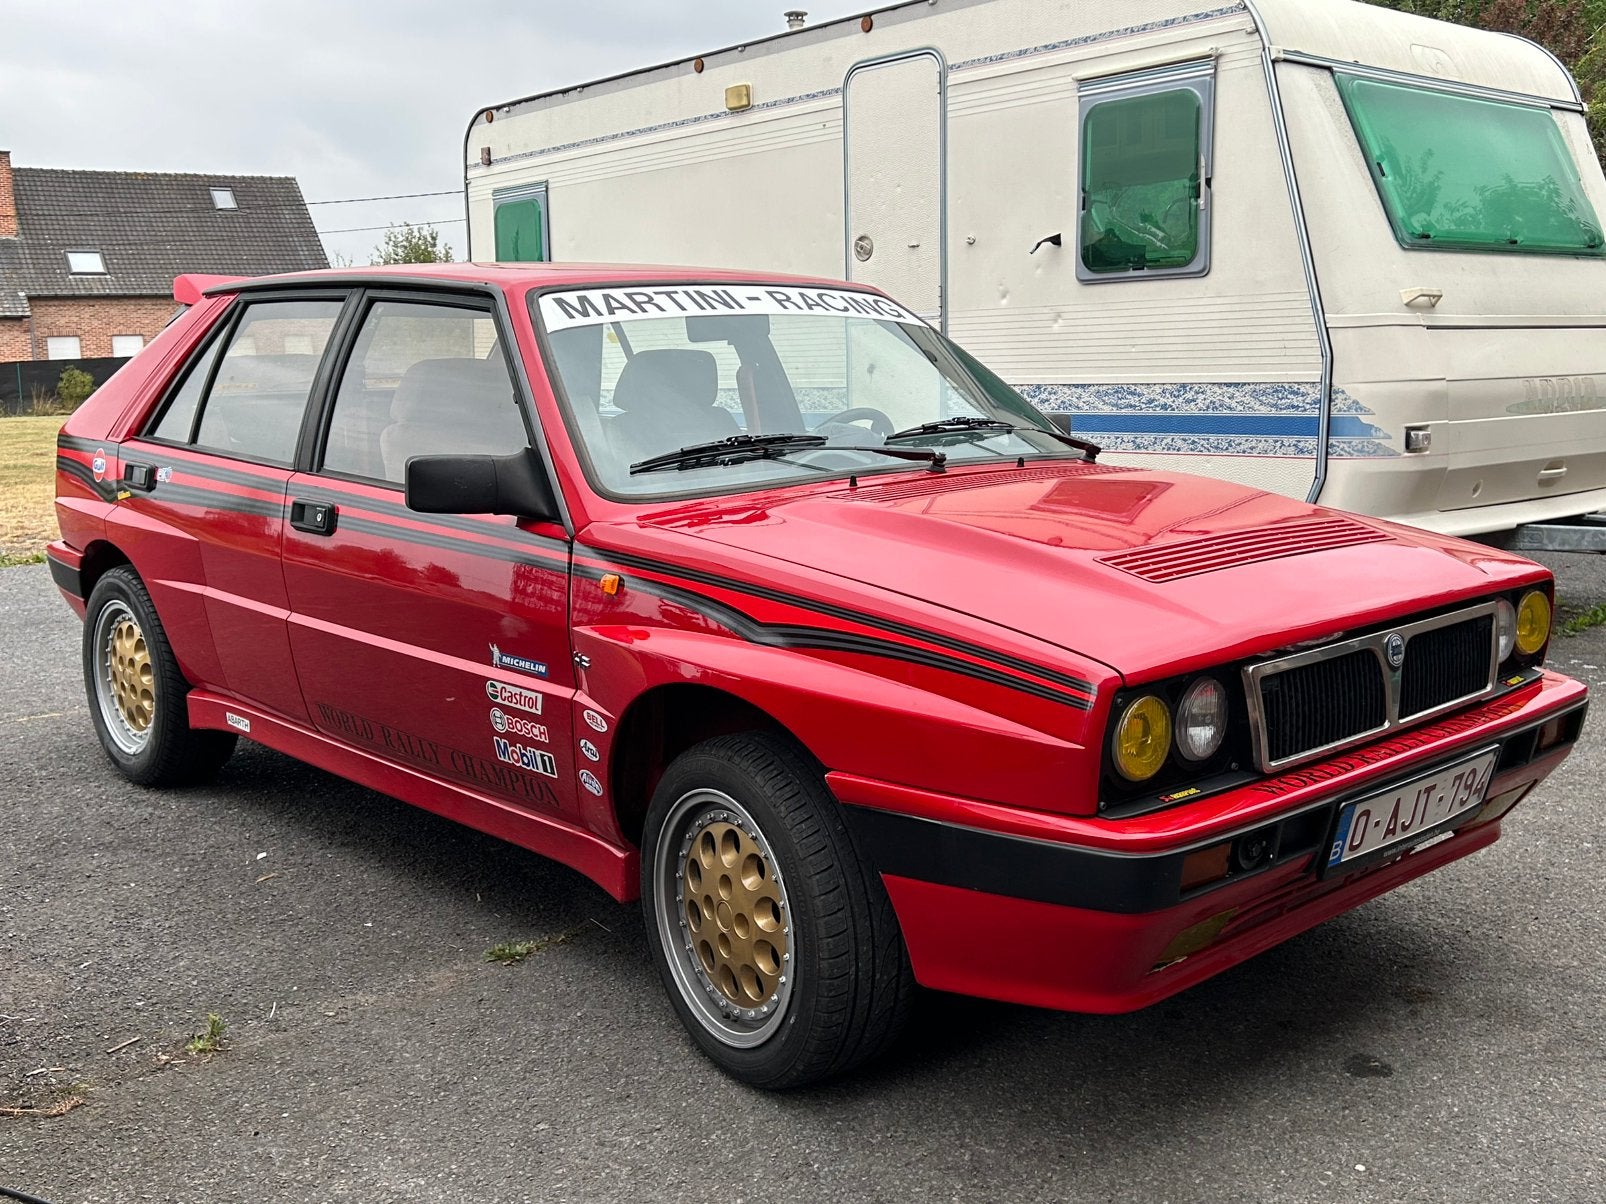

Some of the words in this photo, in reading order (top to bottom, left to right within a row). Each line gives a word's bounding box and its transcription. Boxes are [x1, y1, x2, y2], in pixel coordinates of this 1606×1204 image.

[501, 655, 547, 674] MICHELIN
[499, 686, 540, 711] Castrol
[228, 714, 249, 730] ABARTH
[507, 716, 549, 741] BOSCH
[587, 711, 606, 730] BELL
[317, 703, 375, 742] WORLD
[380, 725, 441, 766] RALLY
[451, 749, 560, 807] CHAMPION
[495, 738, 540, 772] Mobil
[542, 753, 555, 774] 1
[1348, 760, 1494, 852] O-AJT-794
[1328, 840, 1343, 861] B
